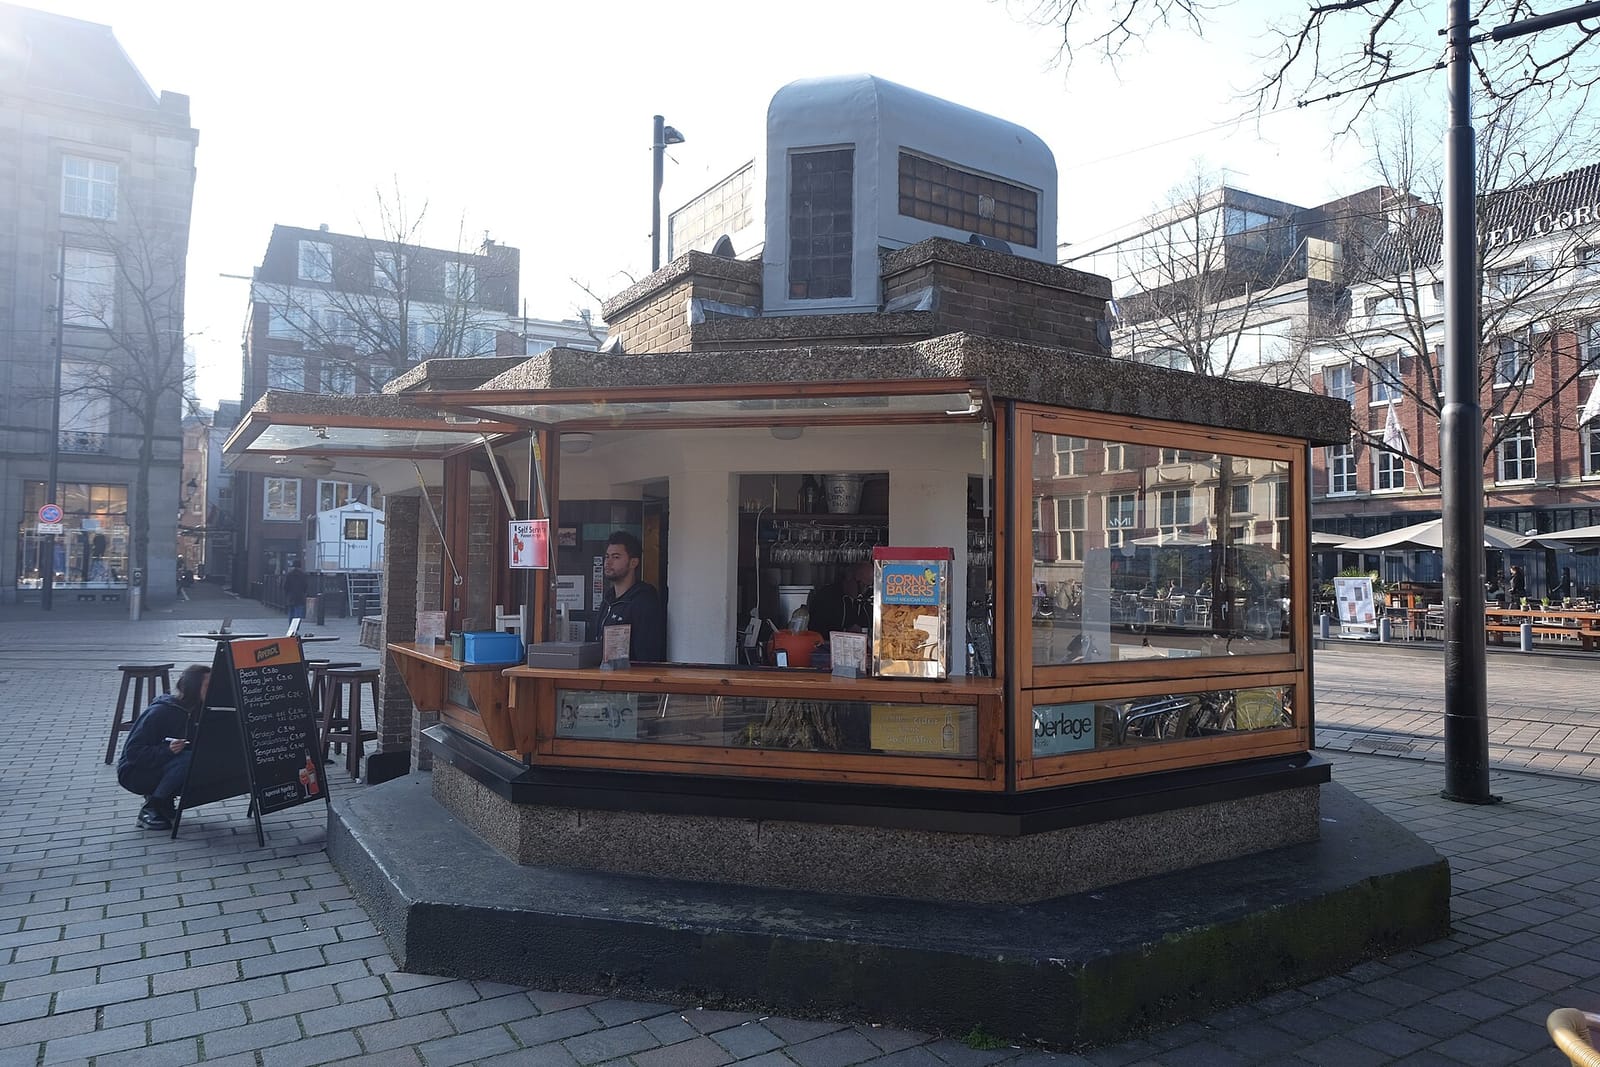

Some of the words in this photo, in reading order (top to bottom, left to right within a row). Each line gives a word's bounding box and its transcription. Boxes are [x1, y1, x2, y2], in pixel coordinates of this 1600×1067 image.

[886, 584, 934, 597] BAKERS
[257, 646, 279, 661] APEROL
[1034, 712, 1092, 740] berlage
